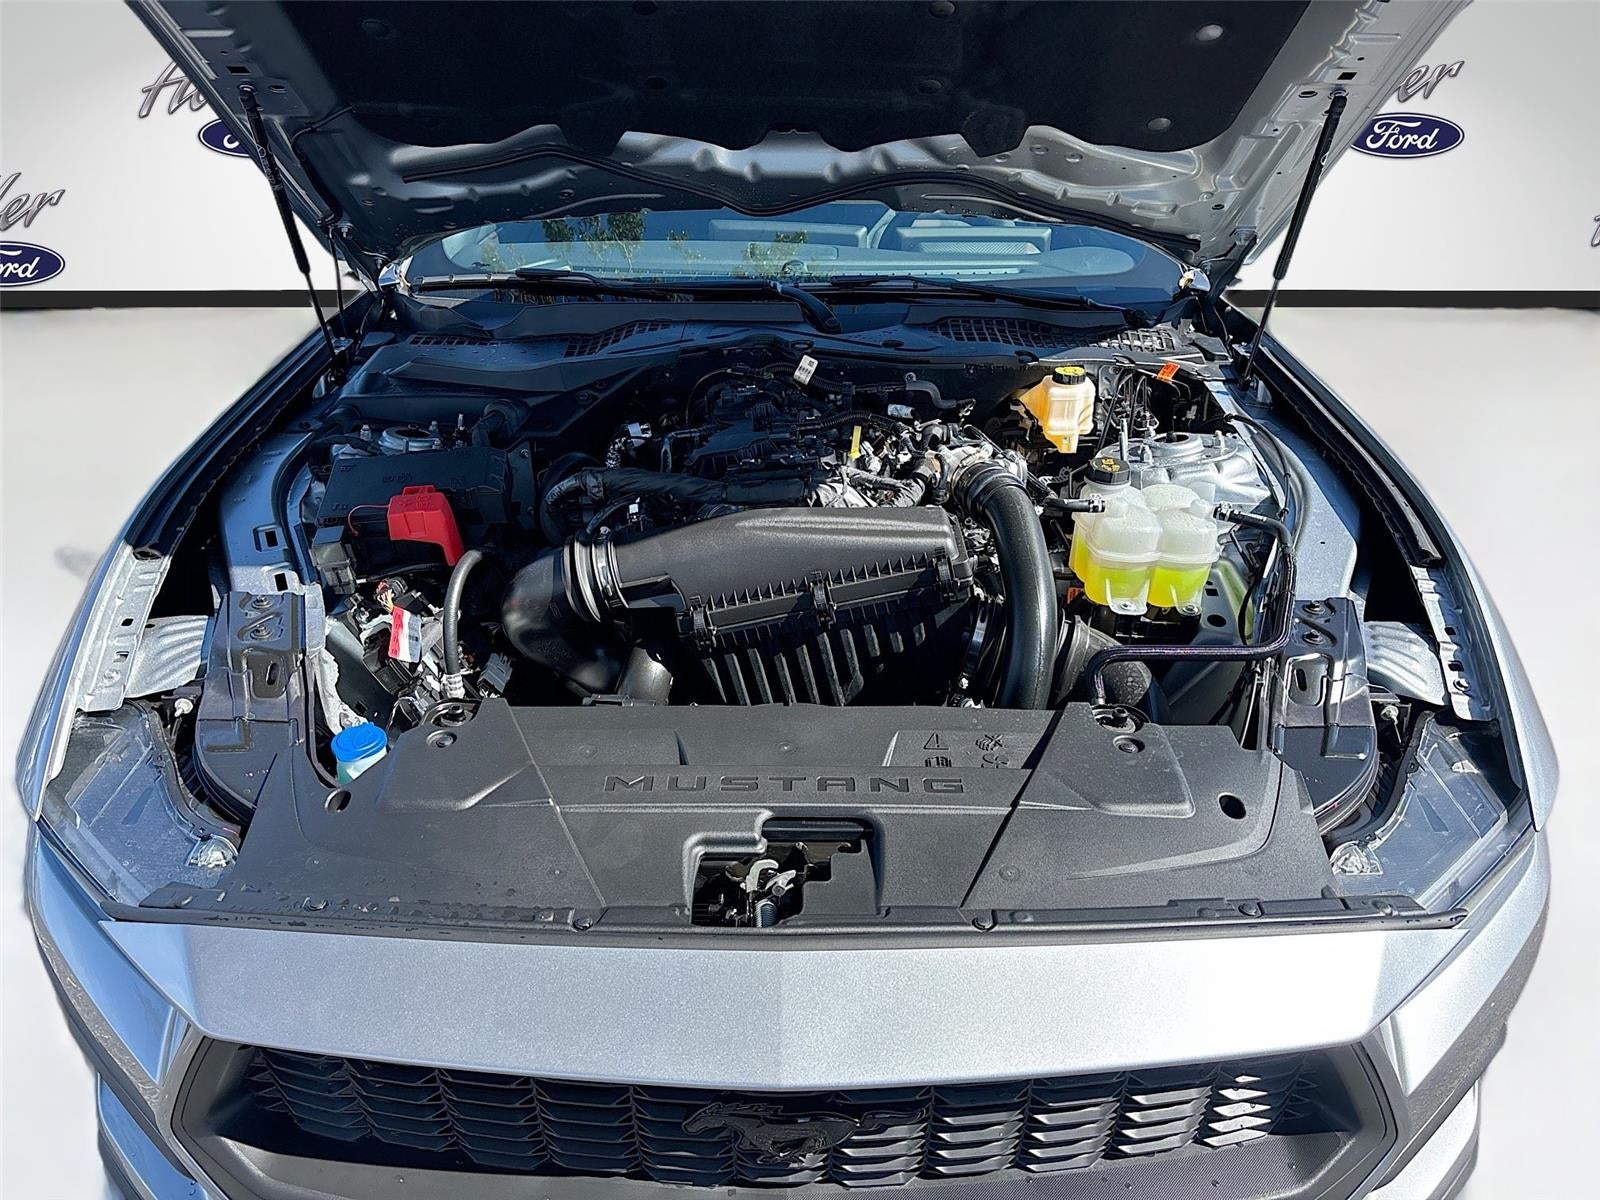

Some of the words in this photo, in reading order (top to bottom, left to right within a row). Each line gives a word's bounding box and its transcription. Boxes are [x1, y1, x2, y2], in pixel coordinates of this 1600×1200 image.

[1366, 119, 1440, 149] Ford
[0, 250, 40, 278] rd
[604, 775, 964, 793] MUSTANG
